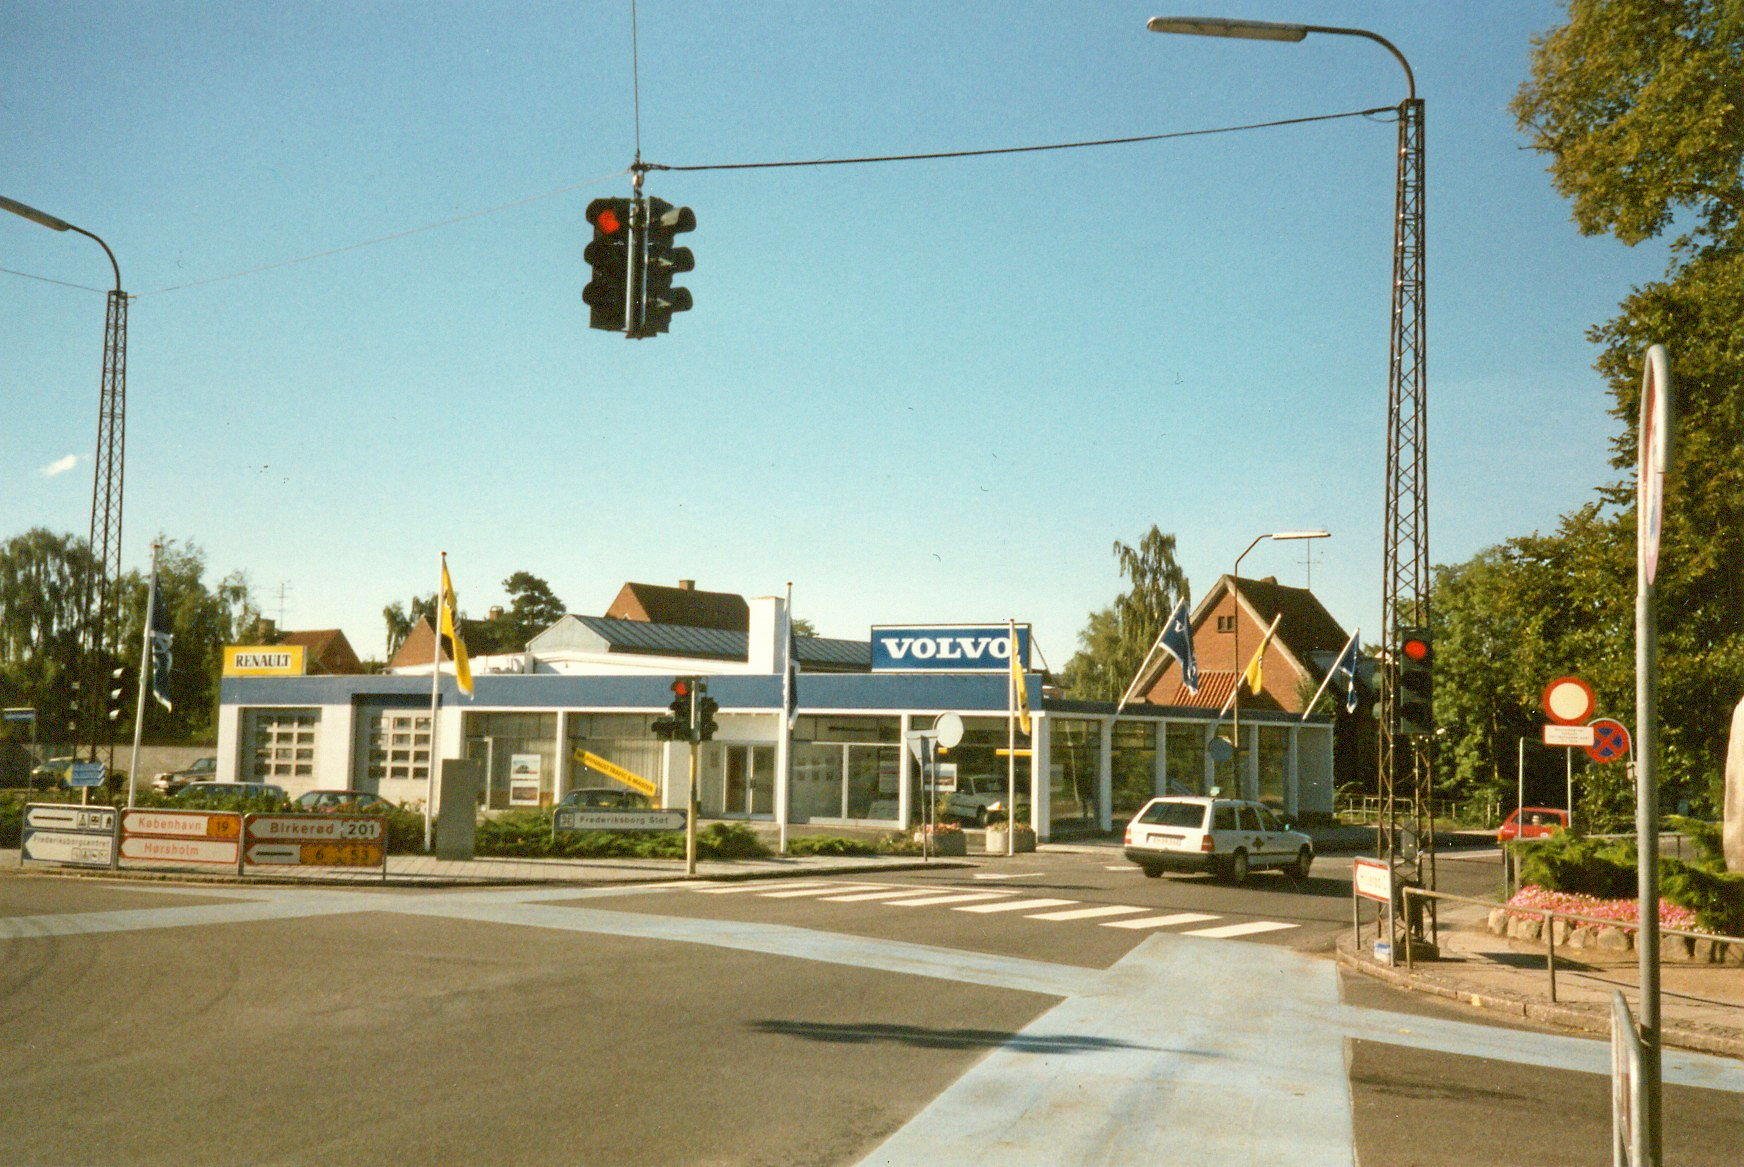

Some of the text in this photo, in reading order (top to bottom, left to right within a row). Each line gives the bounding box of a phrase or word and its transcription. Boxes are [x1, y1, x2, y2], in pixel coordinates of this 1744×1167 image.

[881, 637, 1012, 659] VOLVO
[235, 654, 291, 667] RENAULT
[138, 818, 229, 832] København 19
[269, 822, 375, 835] Birkerød 201
[144, 843, 199, 855] Hørsholm
